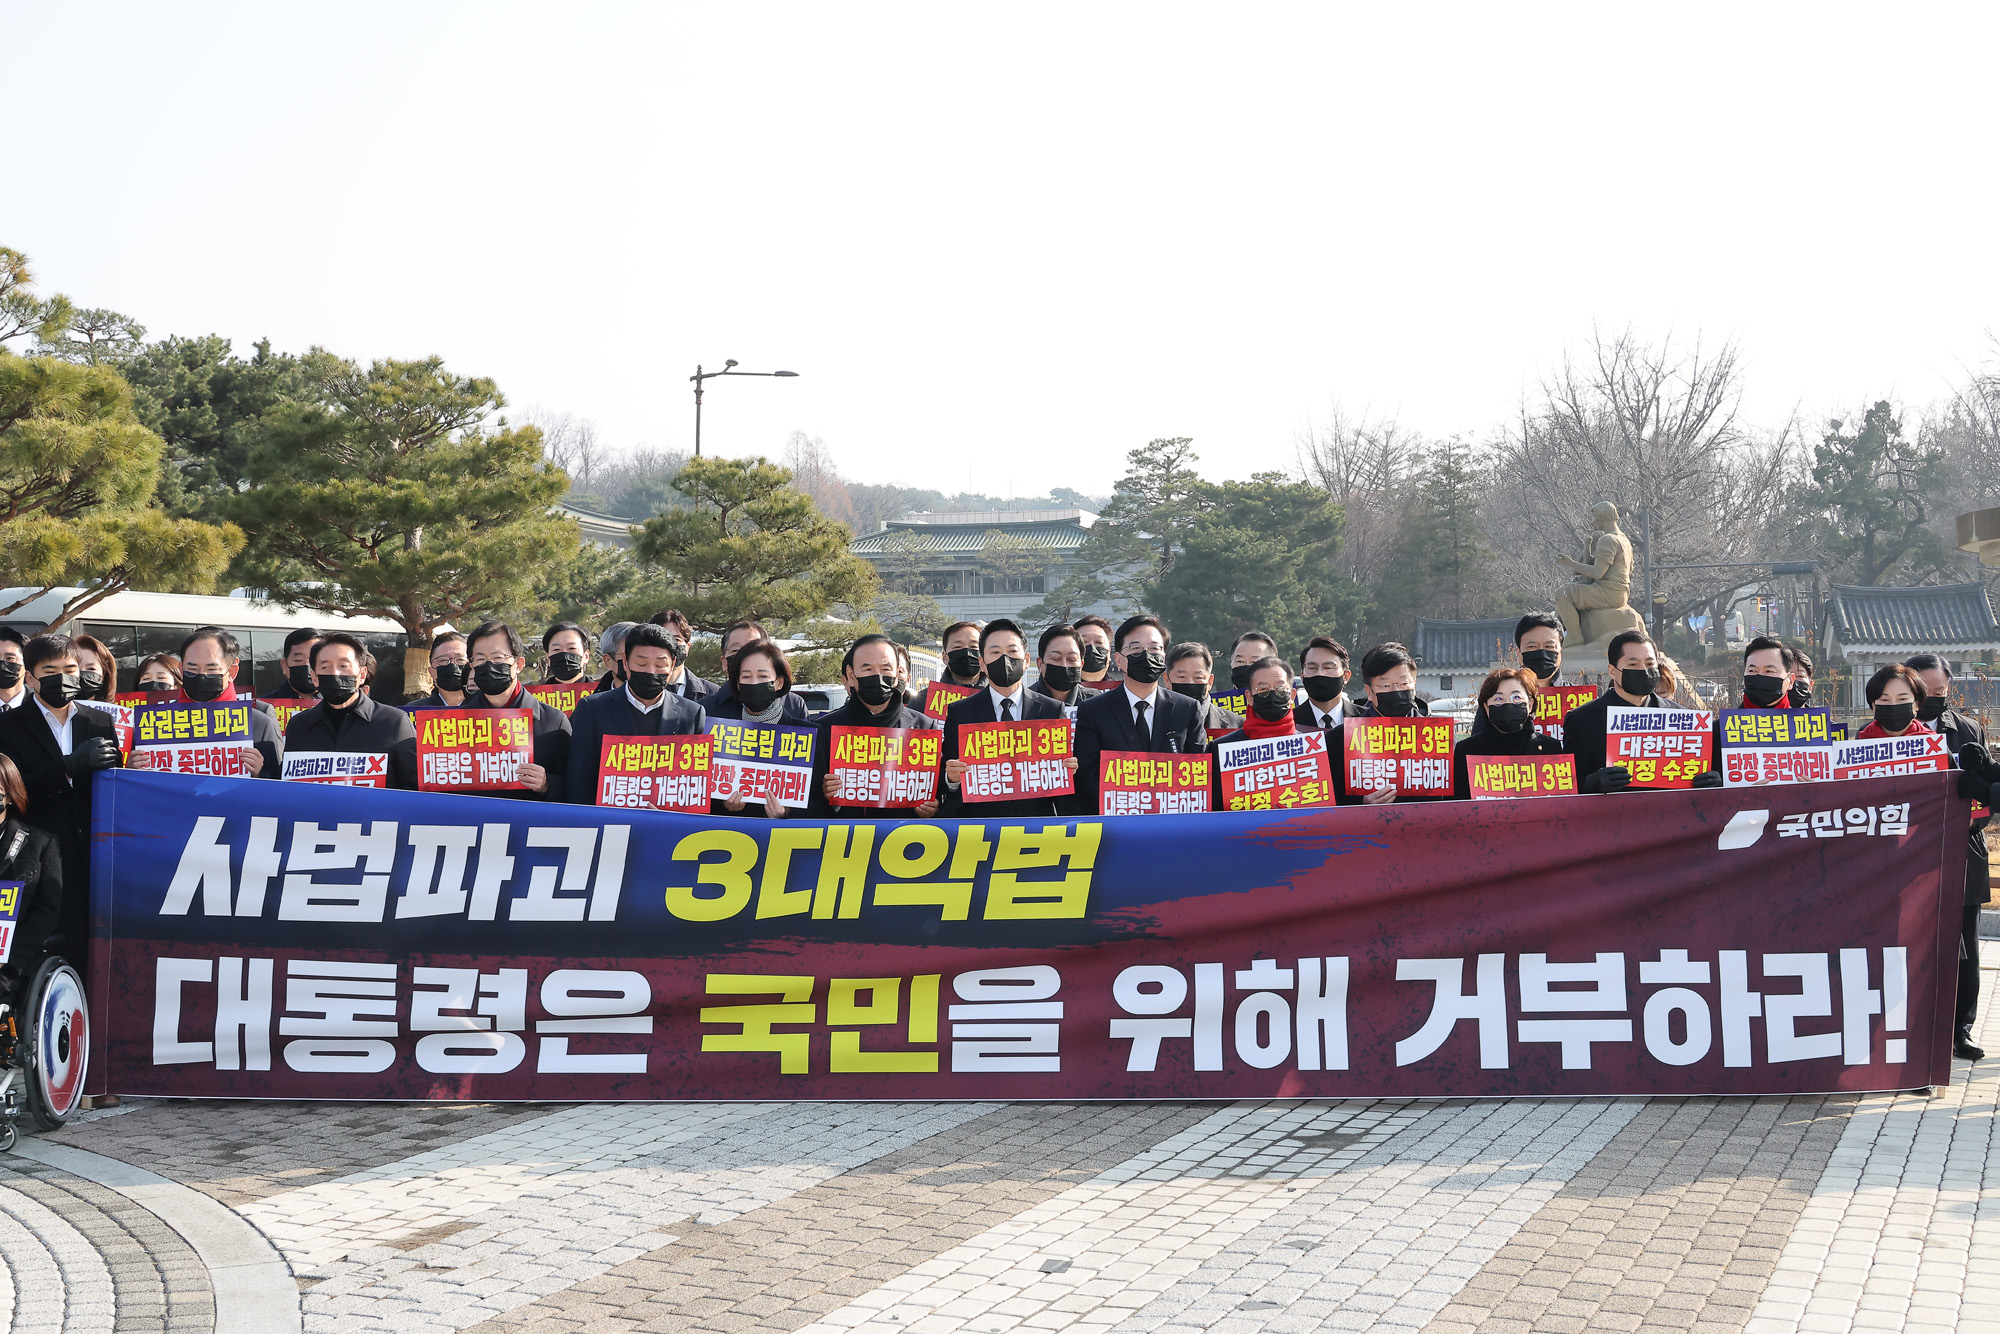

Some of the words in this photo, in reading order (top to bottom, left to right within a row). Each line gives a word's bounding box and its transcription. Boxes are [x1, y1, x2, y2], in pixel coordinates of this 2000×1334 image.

[138, 708, 208, 740] 삼권분립
[213, 706, 249, 737] 파괴
[422, 717, 492, 748] 사법파괴
[498, 716, 529, 747] 3법
[1610, 713, 1666, 731] 사법파괴
[1669, 713, 1693, 731] 악법
[1725, 714, 1790, 743] 삼권분립
[1793, 713, 1828, 742] 파괴
[709, 724, 776, 758] 삼권분립
[778, 731, 813, 762] 파괴
[834, 734, 903, 765] 사법파괴
[908, 737, 938, 766] 3법
[964, 728, 1032, 759] 사법파괴
[1037, 726, 1068, 755] 3법
[1223, 743, 1274, 768] 사법파괴
[1276, 737, 1304, 758] 악법
[1349, 725, 1417, 754] 사법파괴
[1421, 725, 1450, 753] 3법
[1619, 735, 1703, 758] 대한민국
[1837, 742, 1893, 765] 사법파괴
[1896, 738, 1925, 757] 악법
[284, 757, 334, 777] 사법파괴
[336, 756, 366, 774] 악법
[422, 752, 473, 785] 대통령은
[605, 743, 675, 771] 사법파괴
[679, 742, 709, 771] 3법
[1727, 753, 1759, 782] 당장
[1763, 751, 1830, 782] 중단하라!
[739, 767, 807, 801] 중단하라!
[834, 767, 880, 802] 대통령은
[884, 770, 935, 802] 거부하라!
[965, 762, 1015, 796] 대통령은
[1015, 759, 1070, 793] 거부하라!
[1104, 759, 1172, 787] 사법파괴
[1178, 760, 1208, 786] 3법
[1233, 757, 1319, 793] 대한민국
[1349, 759, 1397, 790] 대통령은
[1400, 758, 1449, 790] 거부하라!
[1474, 763, 1537, 792] 사법파괴
[1542, 762, 1573, 790] 3법
[602, 775, 652, 807] 대통령은
[655, 774, 707, 807] 거부하라!
[1278, 780, 1330, 808] 수호!
[1776, 803, 1910, 839] 국민의힘
[159, 816, 631, 922] 사법파괴
[666, 823, 1102, 921] 3대악법
[153, 957, 653, 1074] 대통령은
[700, 965, 1063, 1073] 국민을
[1110, 956, 1349, 1072] 위해
[1396, 947, 1908, 1070] 거부하라!
